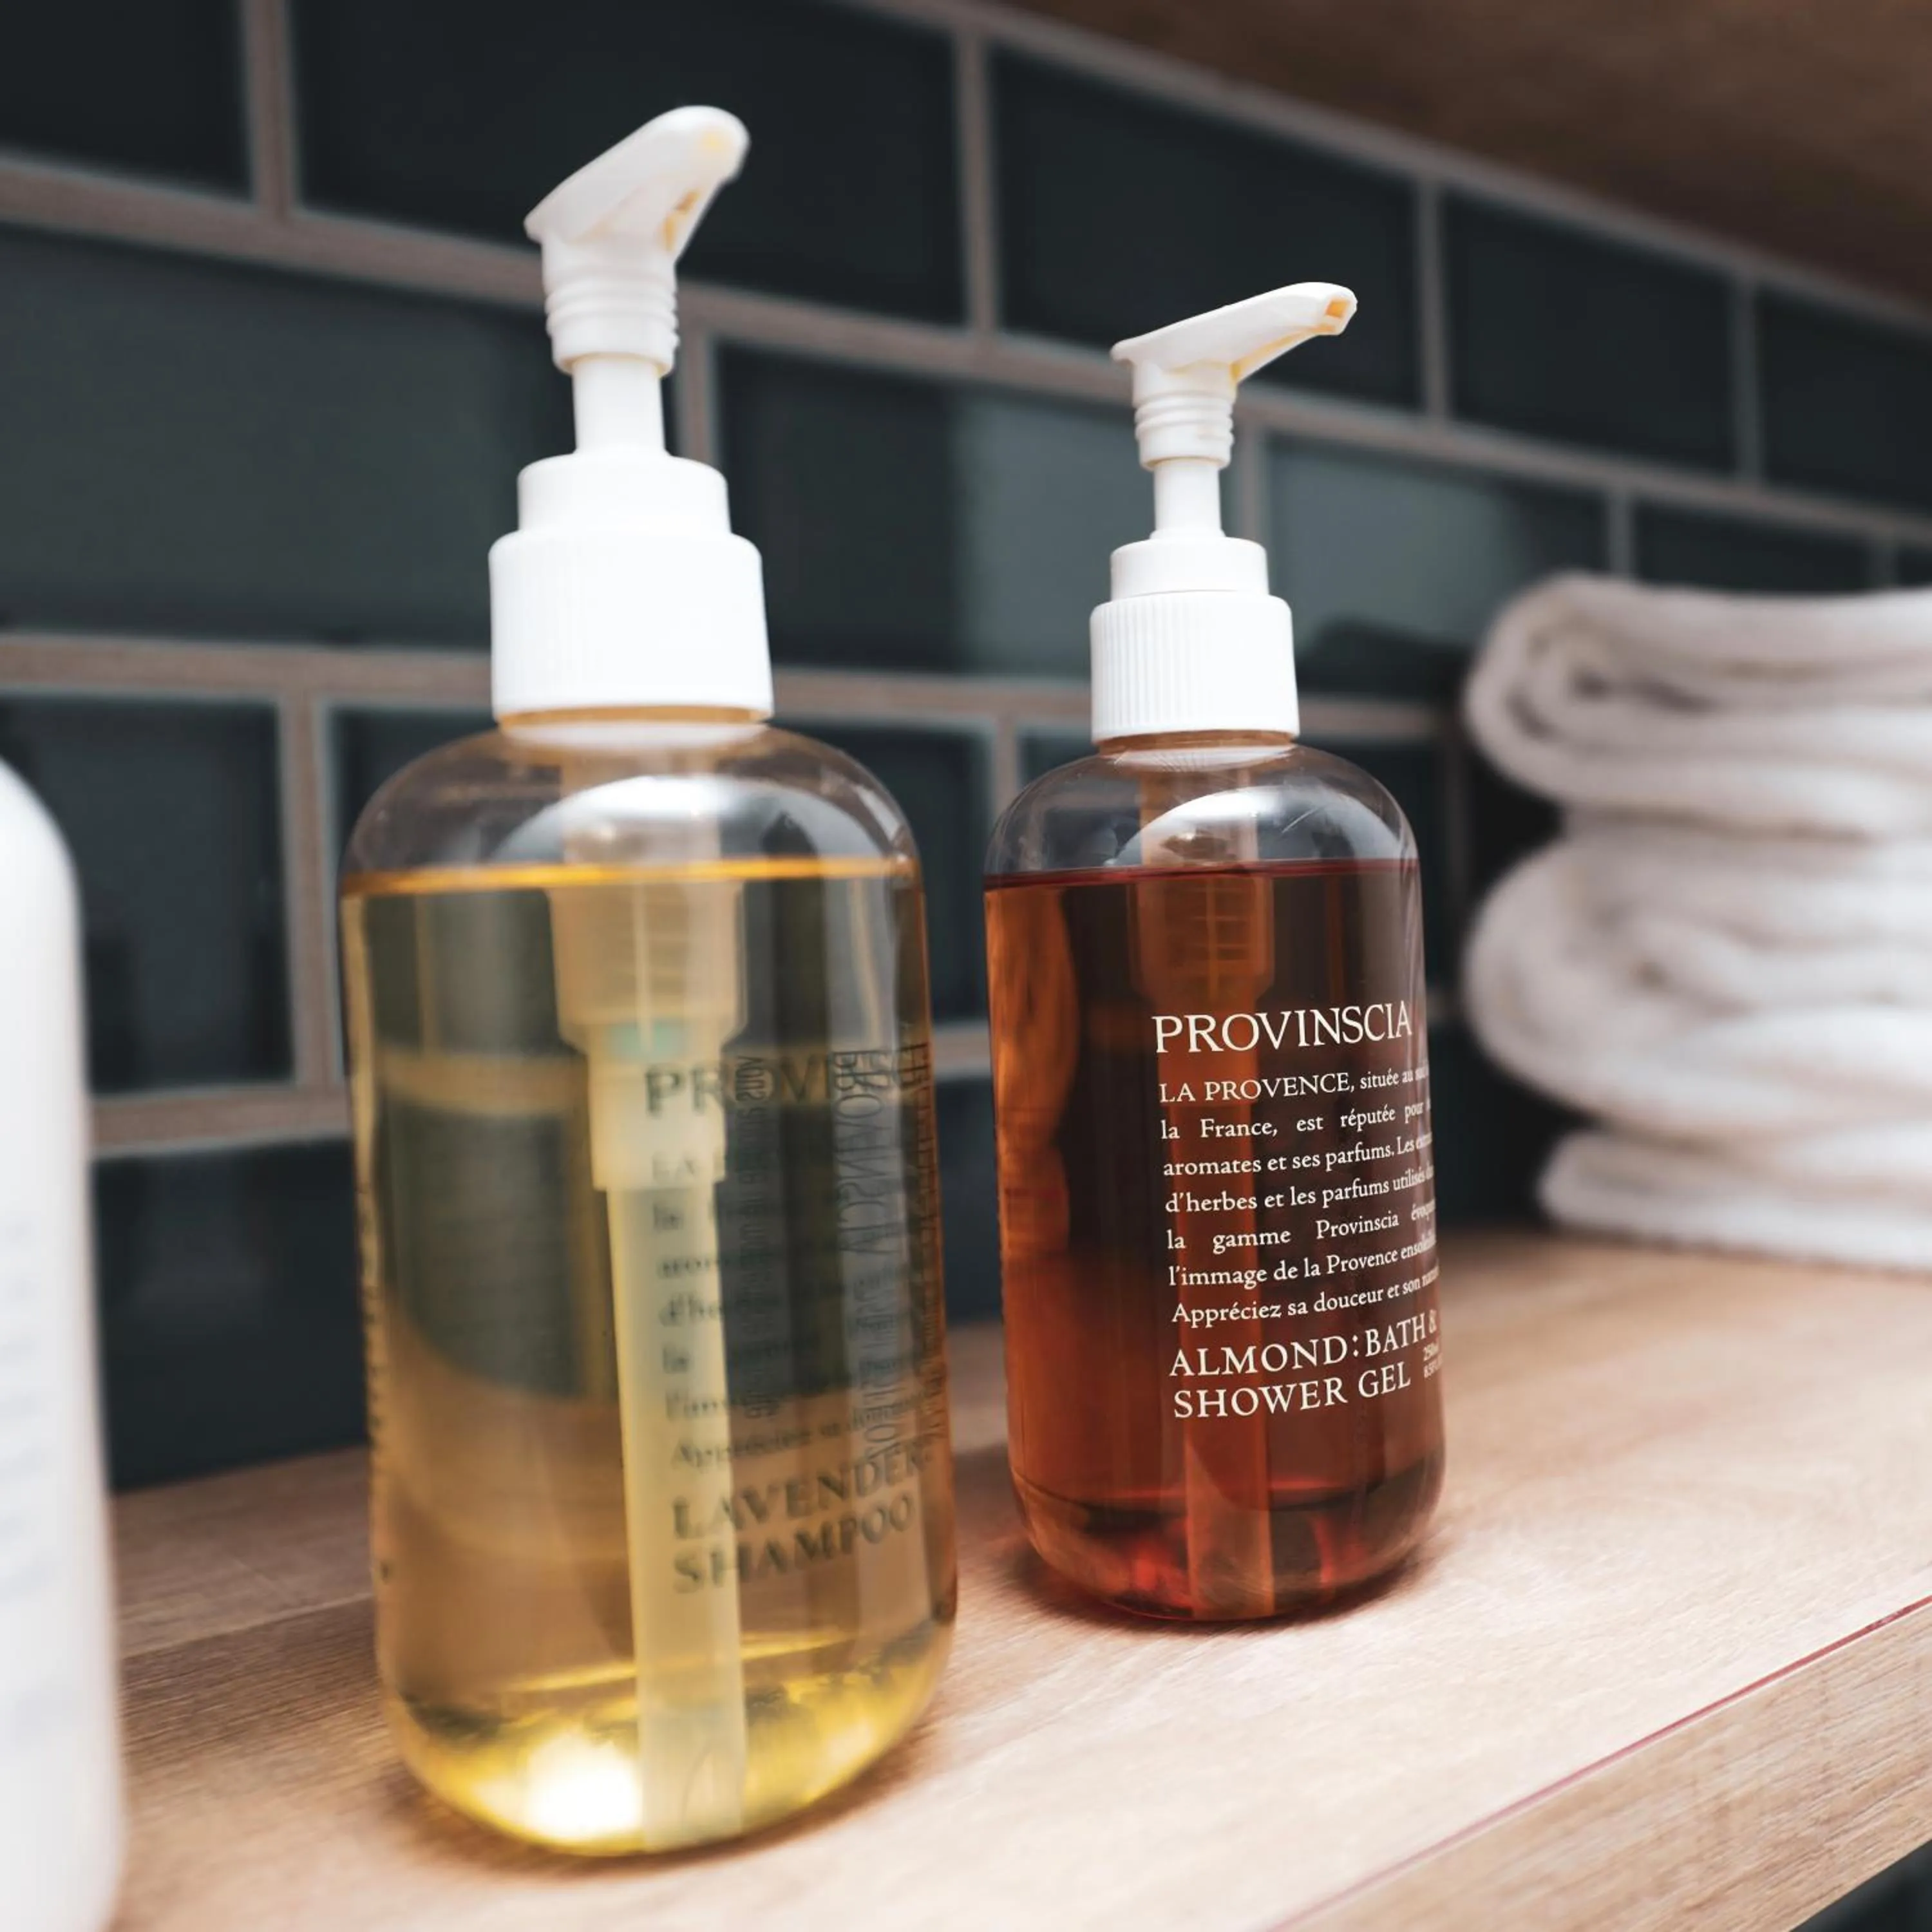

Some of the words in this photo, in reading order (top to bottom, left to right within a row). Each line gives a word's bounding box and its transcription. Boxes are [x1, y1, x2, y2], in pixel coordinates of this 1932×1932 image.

[1151, 999, 1413, 1054] PROVINSCIA
[1159, 1083, 1196, 1103] LA
[1204, 1072, 1354, 1101] PROVENCE,
[1360, 1068, 1399, 1089] située
[1161, 1119, 1180, 1139] la
[1200, 1118, 1278, 1138] France,
[1296, 1117, 1323, 1132] est
[1340, 1104, 1396, 1132] réputée
[1164, 1160, 1262, 1176] aromates
[1267, 1157, 1287, 1171] et
[1292, 1154, 1321, 1169] ses
[1165, 1191, 1258, 1213] d'herbes
[1264, 1193, 1284, 1208] et
[1290, 1186, 1316, 1206] les
[1322, 1177, 1390, 1209] parfums
[1167, 1229, 1186, 1249] la
[1213, 1231, 1291, 1255] gamme
[1316, 1210, 1399, 1240] Provinscia
[1169, 1265, 1267, 1290] l'immage
[1273, 1260, 1298, 1280] de
[1303, 1257, 1321, 1278] la
[1326, 1249, 1398, 1274] Provence
[1171, 1301, 1282, 1329] Appréciez
[1287, 1302, 1309, 1316] sa
[1313, 1289, 1384, 1312] douceur
[1387, 1284, 1399, 1299] et
[1402, 1278, 1421, 1295] son
[1173, 1376, 1348, 1418] SHOWER
[1358, 1361, 1411, 1397] GEL
[672, 1492, 914, 1594] SHAMPOO
